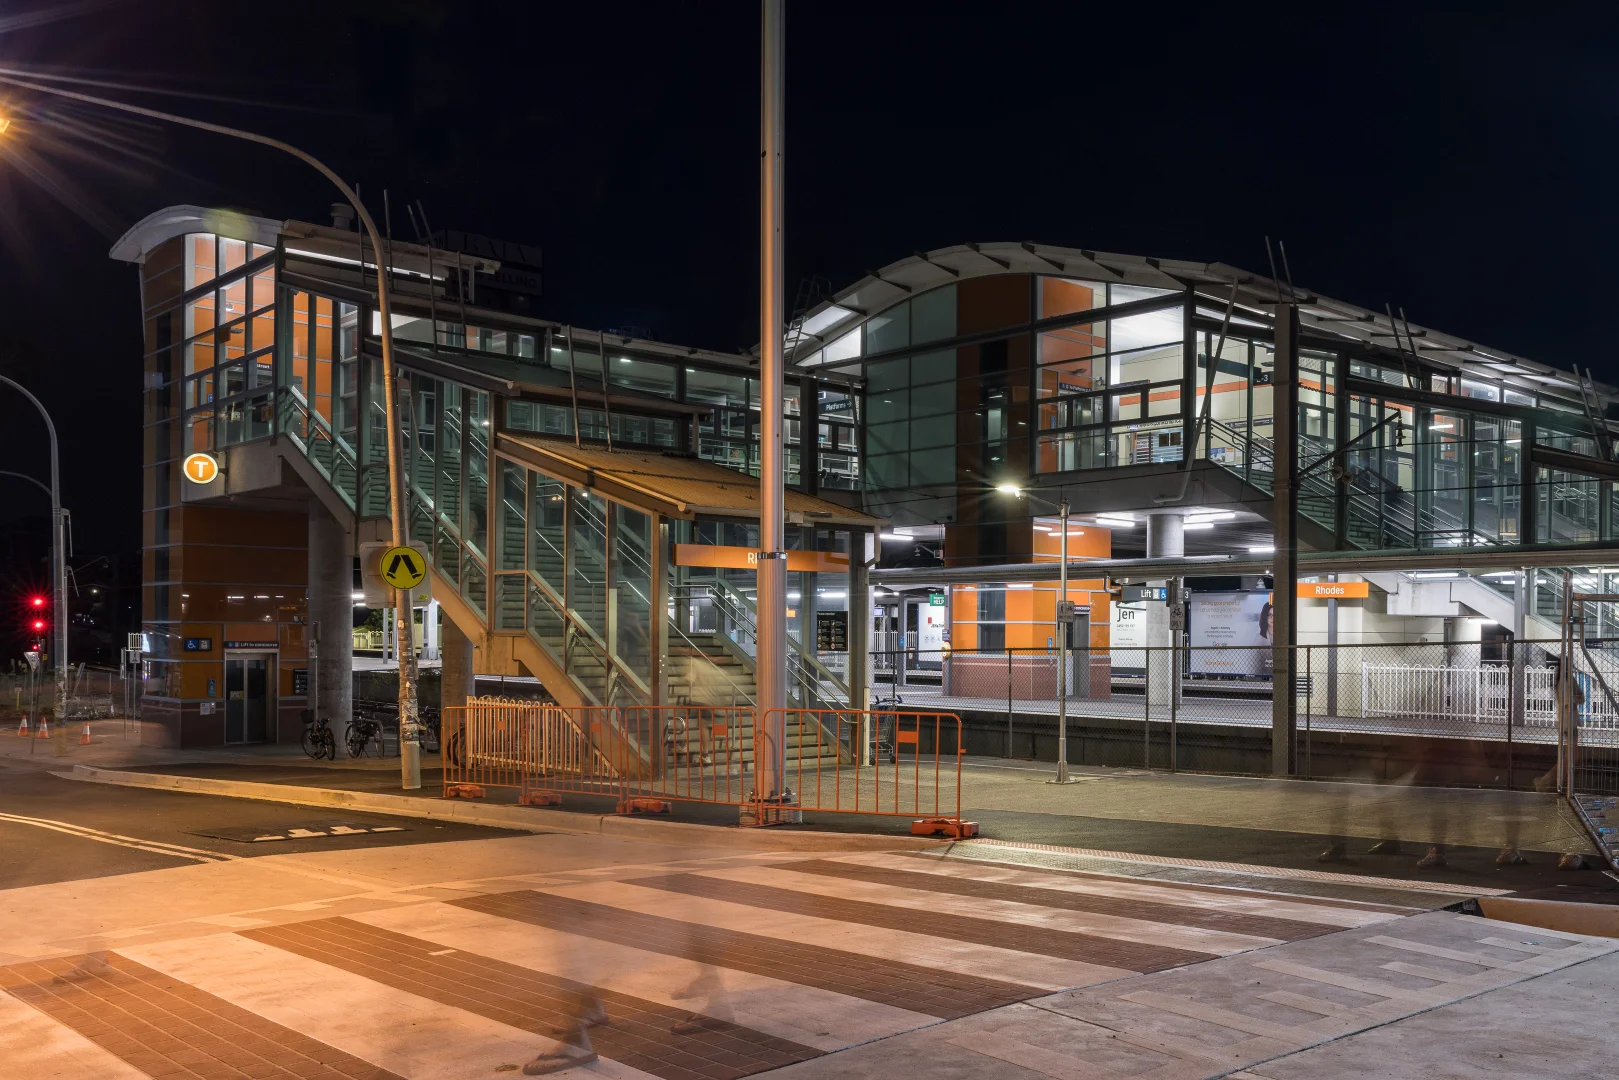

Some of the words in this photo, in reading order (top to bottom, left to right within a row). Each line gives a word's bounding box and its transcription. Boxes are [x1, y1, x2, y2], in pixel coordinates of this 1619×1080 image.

[487, 270, 537, 289] SELLING
[825, 402, 847, 411] Platforms
[193, 460, 209, 478] T
[1140, 589, 1152, 598] Lift
[1184, 591, 1189, 599] 3
[1315, 585, 1345, 595] Rhodes
[1117, 608, 1135, 622] Jen
